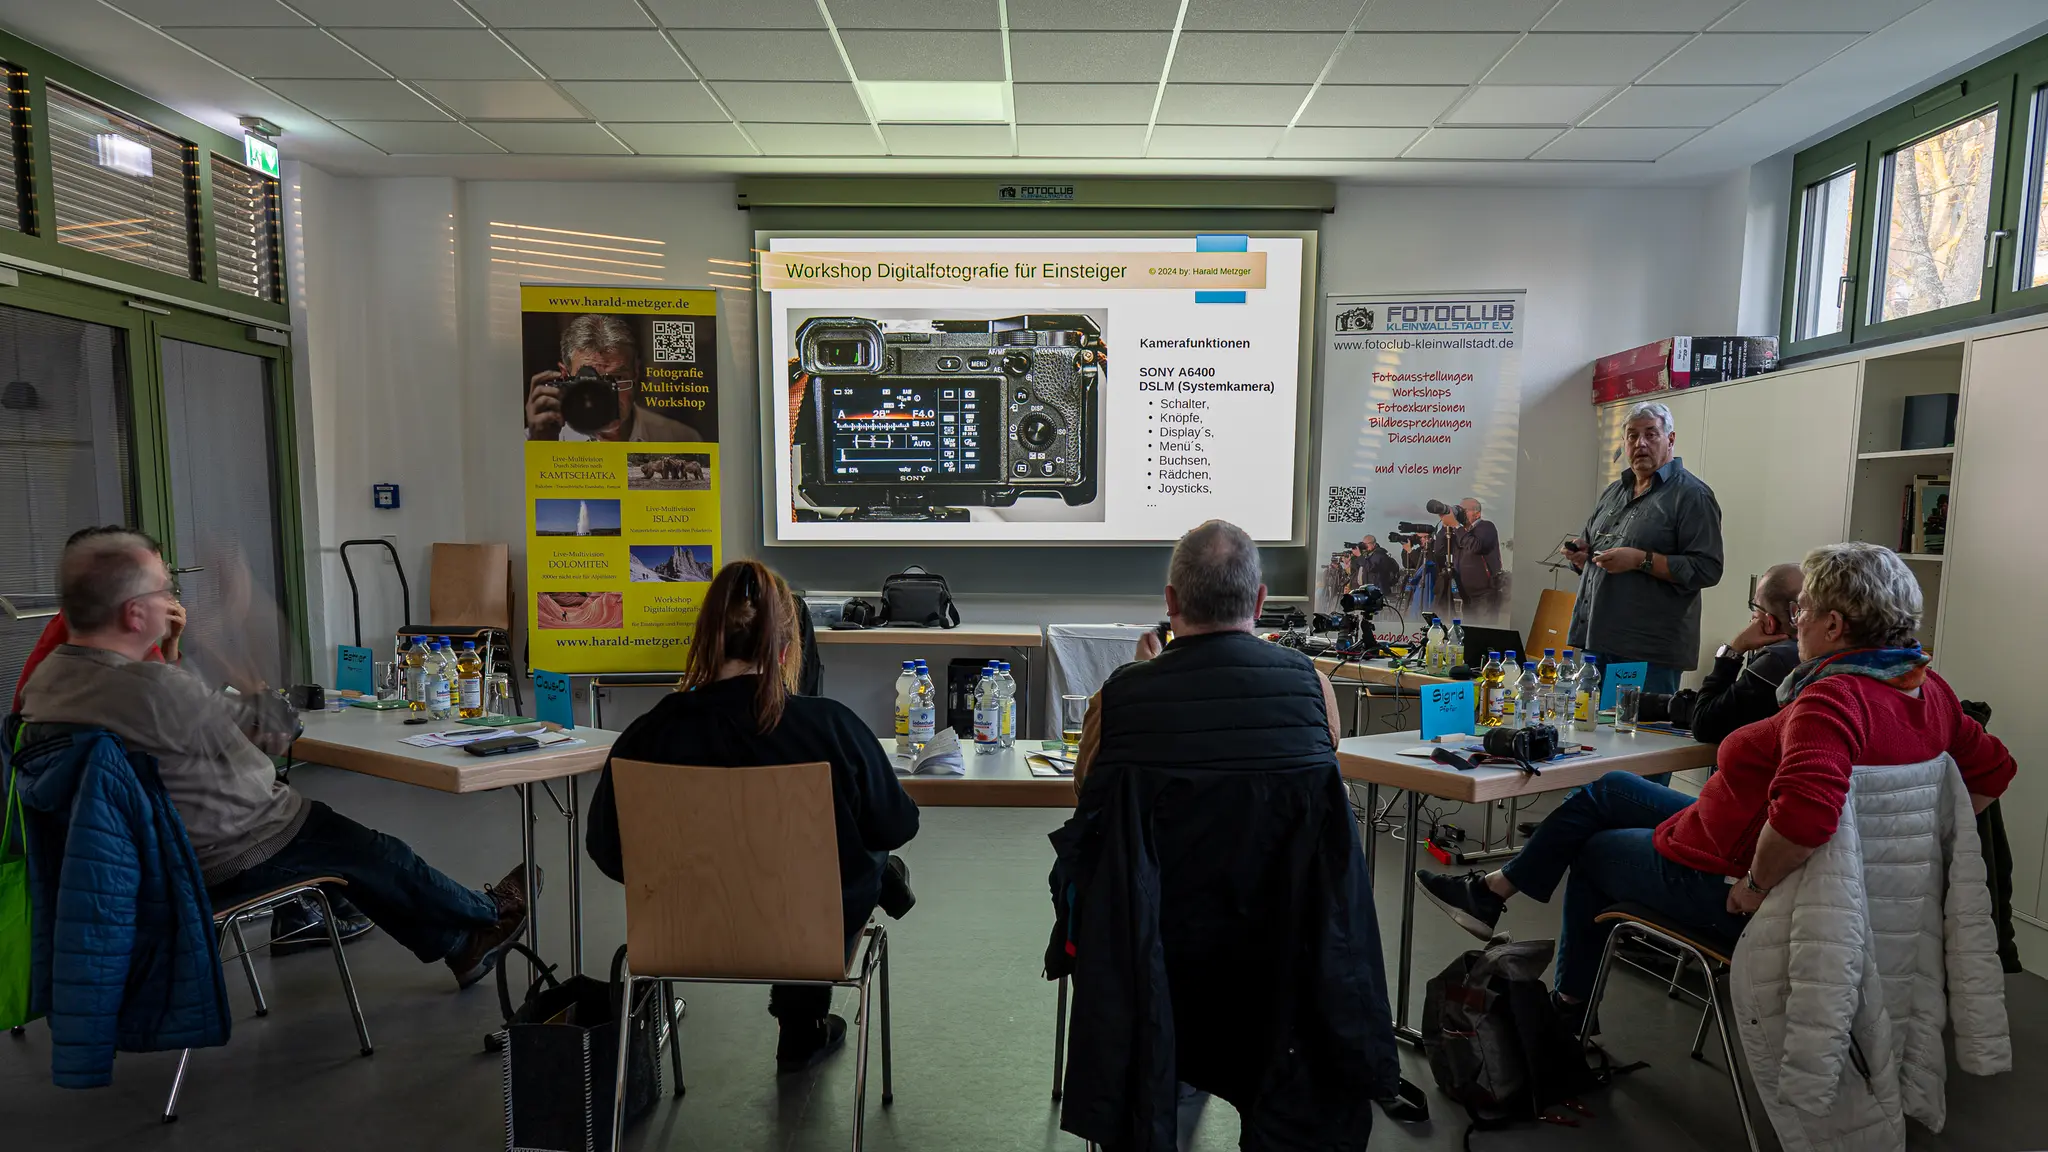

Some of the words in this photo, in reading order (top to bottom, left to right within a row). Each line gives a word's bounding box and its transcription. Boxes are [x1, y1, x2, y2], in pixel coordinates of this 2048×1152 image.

[786, 263, 872, 282] Workshop
[878, 263, 1009, 282] Digitalfotografie
[1014, 263, 1037, 278] für
[1043, 263, 1127, 282] Einsteiger
[1179, 268, 1190, 276] by:
[1220, 268, 1251, 276] Metzger
[549, 296, 689, 310] www.harald-metzger.de
[1386, 304, 1515, 322] FOTOCLUB
[1386, 322, 1489, 331] KLEINWALLSTADT
[1492, 322, 1513, 330] E.V.
[1140, 338, 1250, 348] Kamerafunktionen
[1334, 338, 1514, 350] www.fotoclub-kleinwallstadt.de
[646, 367, 704, 380] Fotografie
[1139, 367, 1175, 377] SONY
[1178, 367, 1215, 377] A6400
[1372, 371, 1474, 386] Fotoausstellungen
[640, 382, 710, 393] Multivision
[1139, 381, 1175, 391] DSLM
[1178, 381, 1275, 394] (Systemkamera)
[1392, 387, 1452, 398] Workshops
[645, 397, 706, 410] Workshop
[1160, 399, 1210, 410] Schalter,
[1376, 402, 1466, 414] Fotoexkursionen
[838, 410, 846, 418] A
[912, 410, 934, 418] F4.0
[1160, 413, 1203, 425] Knöpfe,
[1368, 417, 1472, 432] Bildbesprechungen
[1388, 432, 1451, 444] Diaschauen
[1159, 455, 1211, 466] Buchsen,
[1159, 469, 1211, 480] Rädchen,
[1375, 463, 1394, 474] und
[1398, 463, 1428, 474] vieles
[1432, 464, 1462, 475] mehr
[540, 471, 616, 479] KAMTSCHATKA
[1158, 483, 1212, 495] Joysticks,
[548, 560, 608, 568] DOLOMITEN
[654, 596, 692, 604] Workshop
[556, 636, 691, 648] www.harald-metzger.d
[1373, 632, 1409, 642] achen
[1616, 668, 1637, 679] Klaus
[1432, 686, 1464, 704] Sigrid
